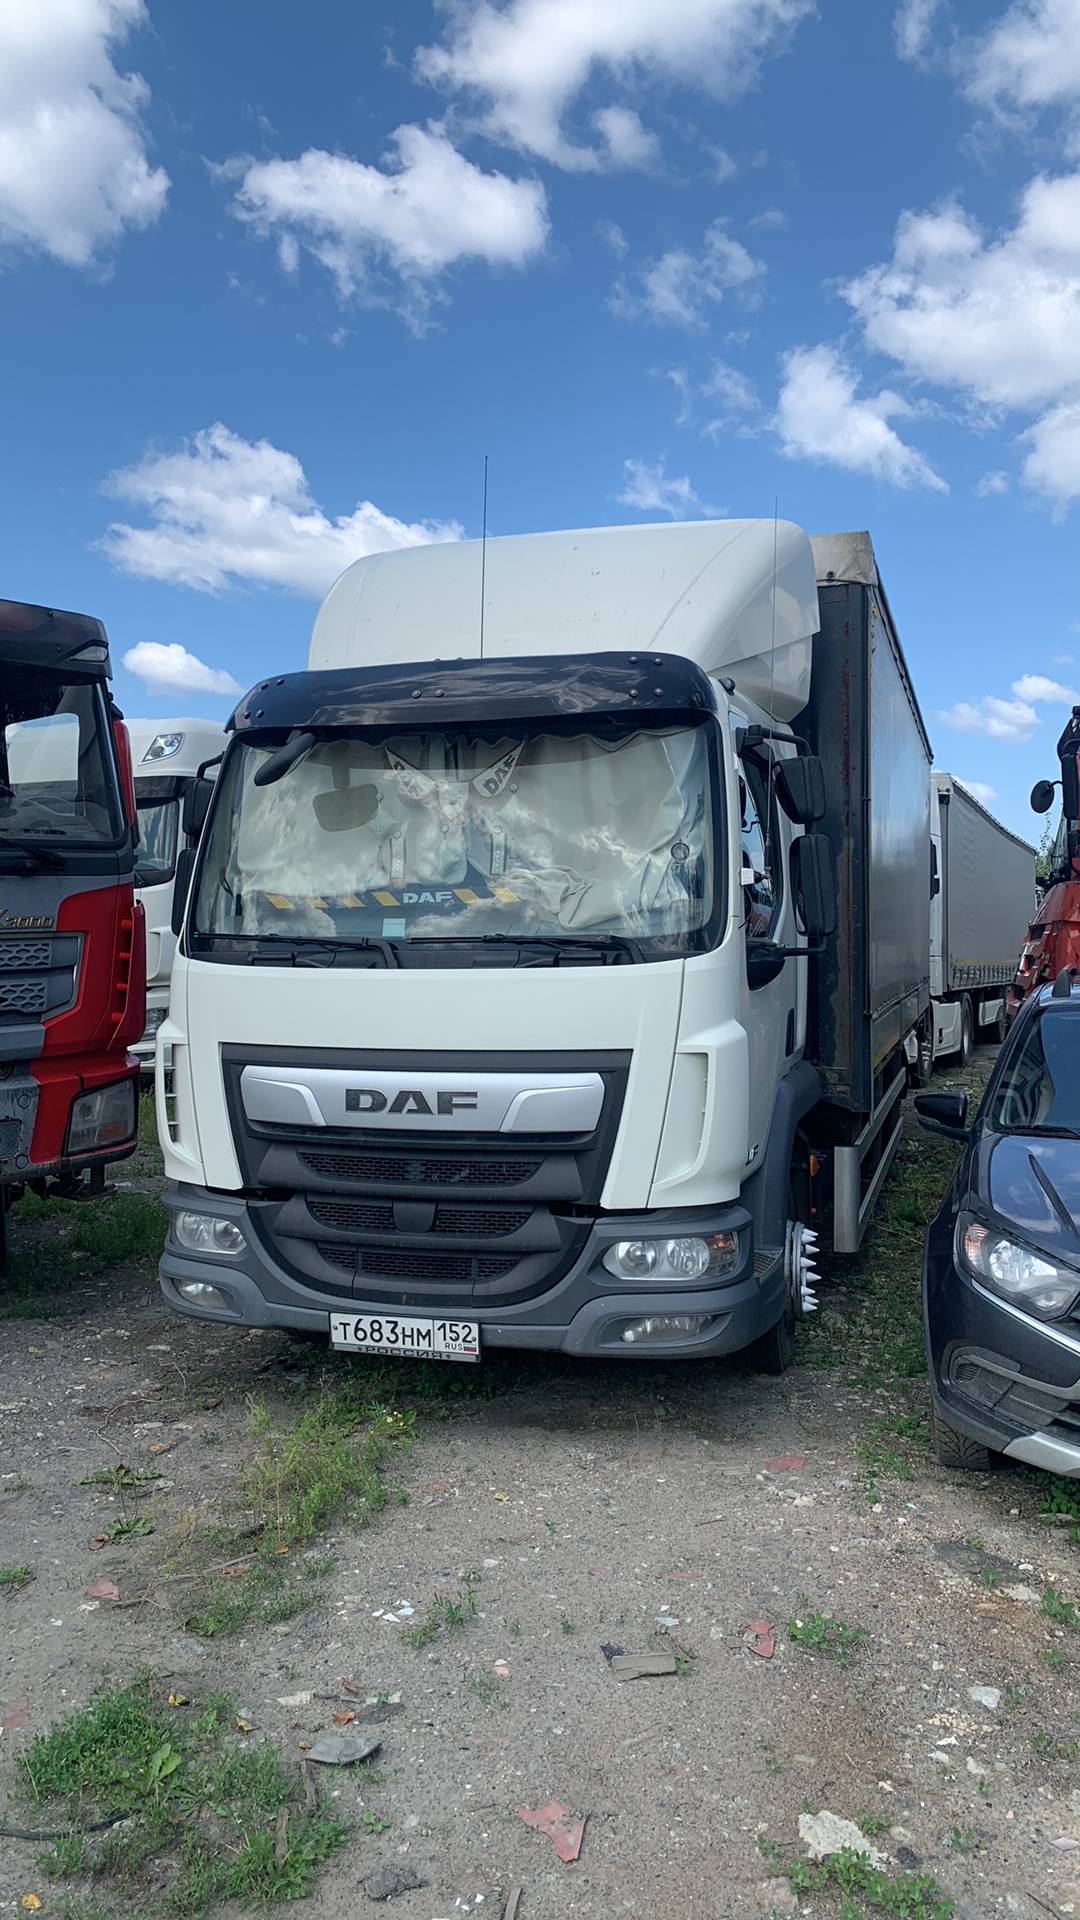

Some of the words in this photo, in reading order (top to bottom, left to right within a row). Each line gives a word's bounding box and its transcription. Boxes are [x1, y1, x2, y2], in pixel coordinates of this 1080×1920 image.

[483, 753, 515, 795] DAF
[403, 891, 452, 904] DAF
[345, 1088, 478, 1116] DAF
[339, 1318, 432, 1348] Т683НМ
[437, 1322, 473, 1344] 152
[365, 1347, 442, 1359] РОССИЯ
[444, 1342, 463, 1351] RUS
